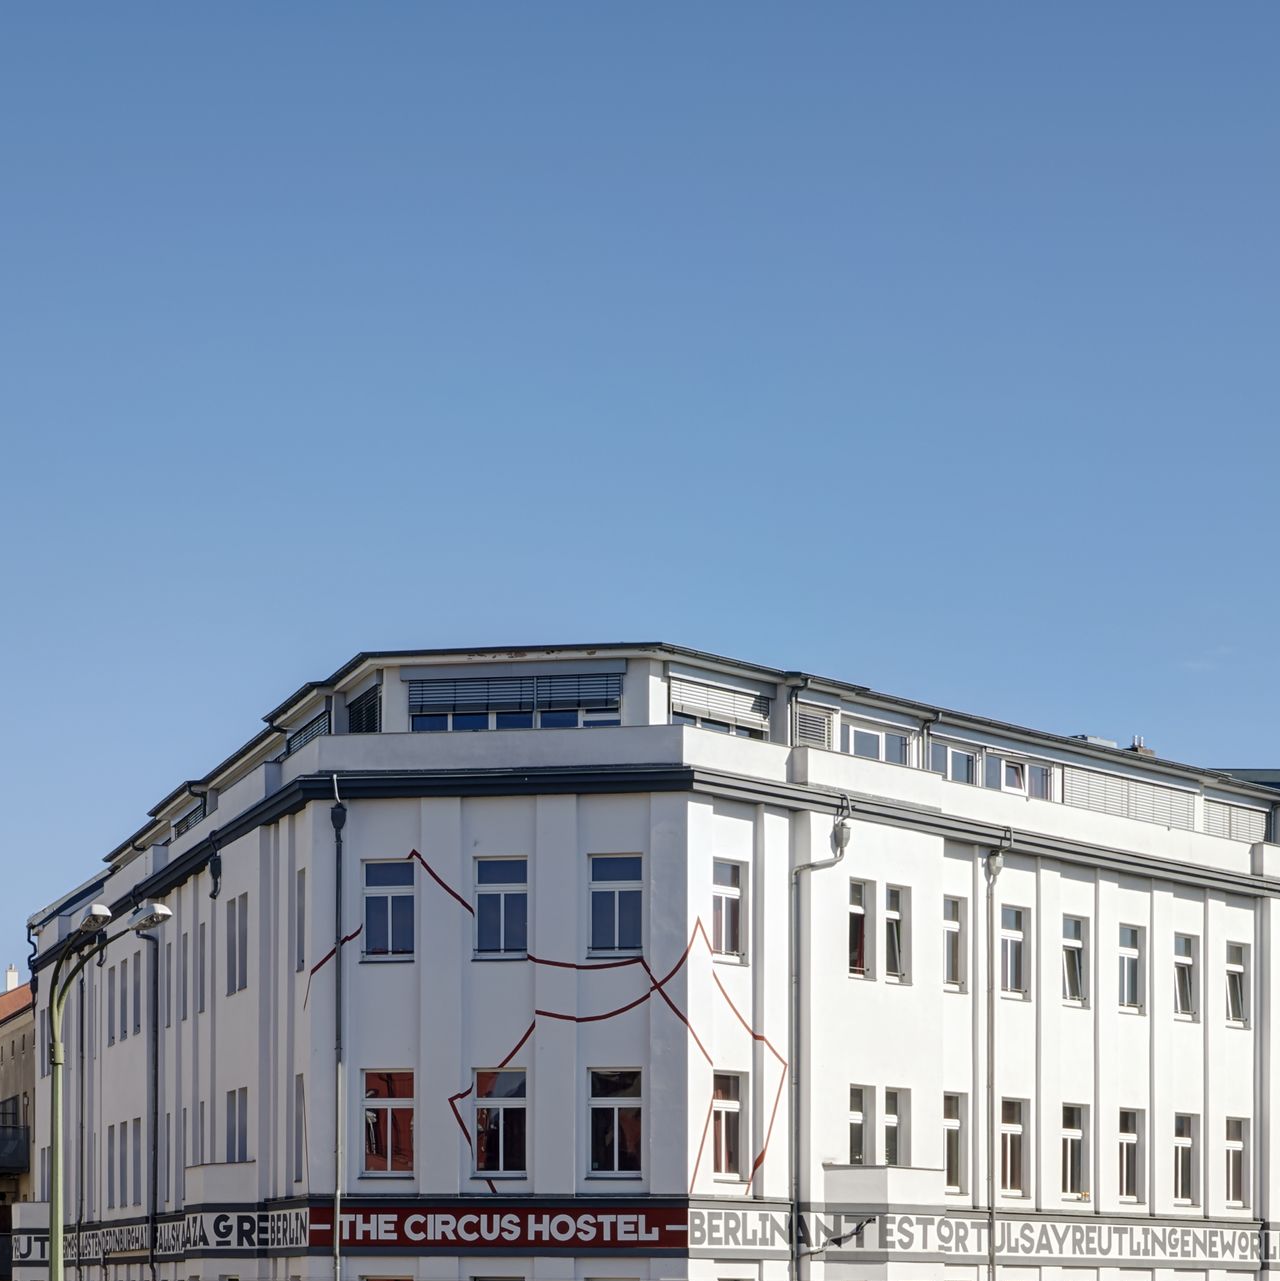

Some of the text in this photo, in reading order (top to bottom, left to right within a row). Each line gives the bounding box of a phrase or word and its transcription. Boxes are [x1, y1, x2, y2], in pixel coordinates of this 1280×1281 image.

[340, 1213, 659, 1241] THE CIRCUS HOSTEL
